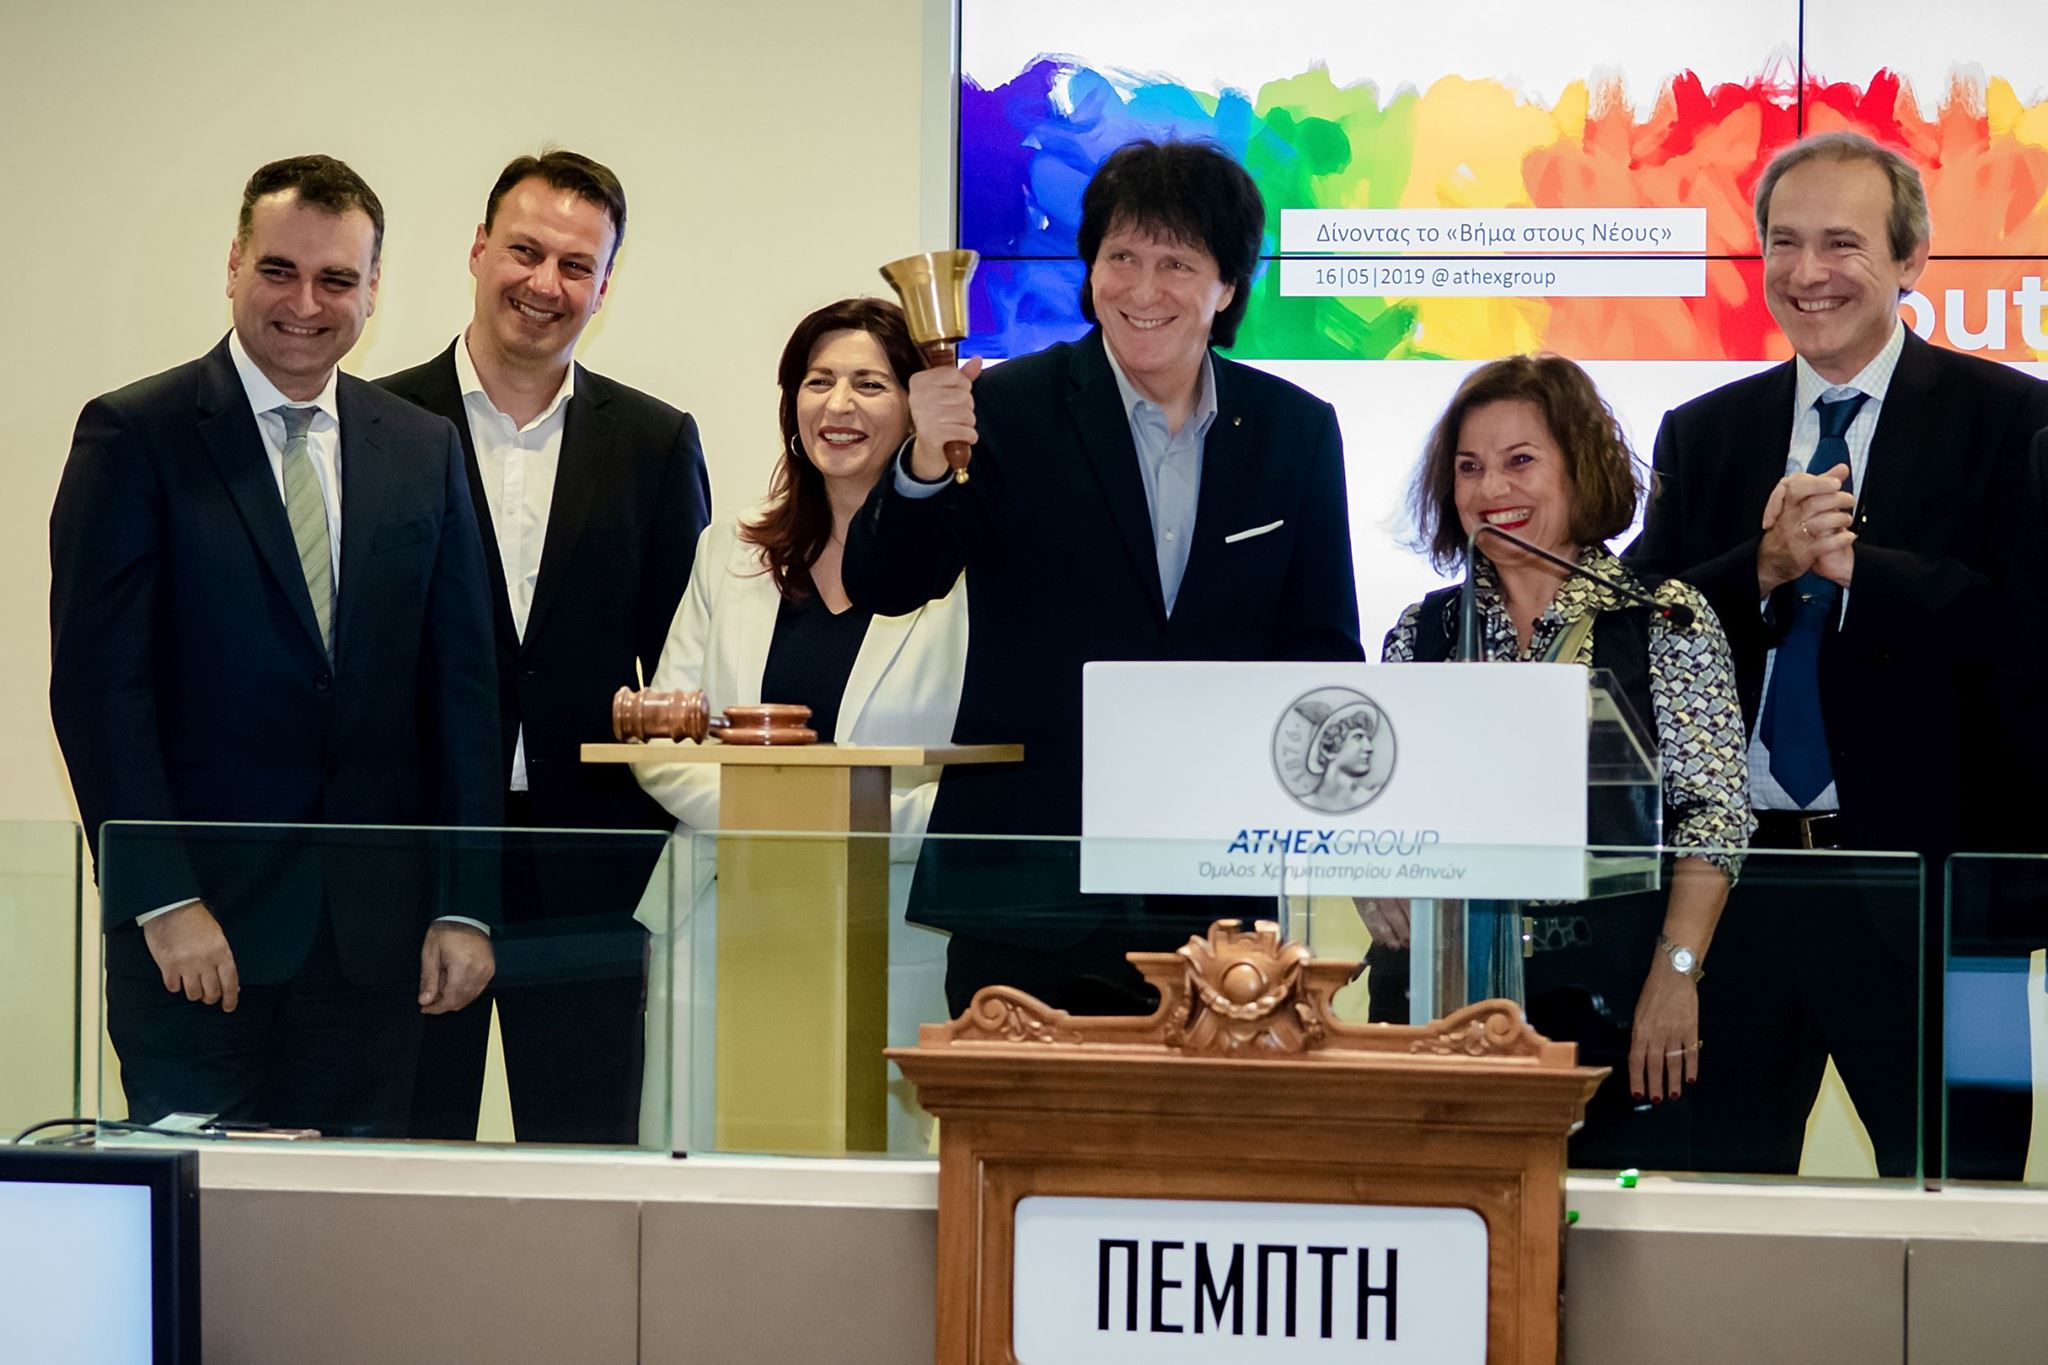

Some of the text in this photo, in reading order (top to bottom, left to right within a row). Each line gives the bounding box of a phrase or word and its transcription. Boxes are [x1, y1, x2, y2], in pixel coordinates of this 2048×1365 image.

[1316, 222, 1672, 246] Δίνοντας το «Βήμα στους Νέους»
[1315, 267, 1425, 288] 16|05|2019
[1198, 861, 1256, 880] Όμιλος
[1398, 863, 1467, 880] Αθηνών
[1097, 1238, 1399, 1342] ΠΕΜΠΤΗ
